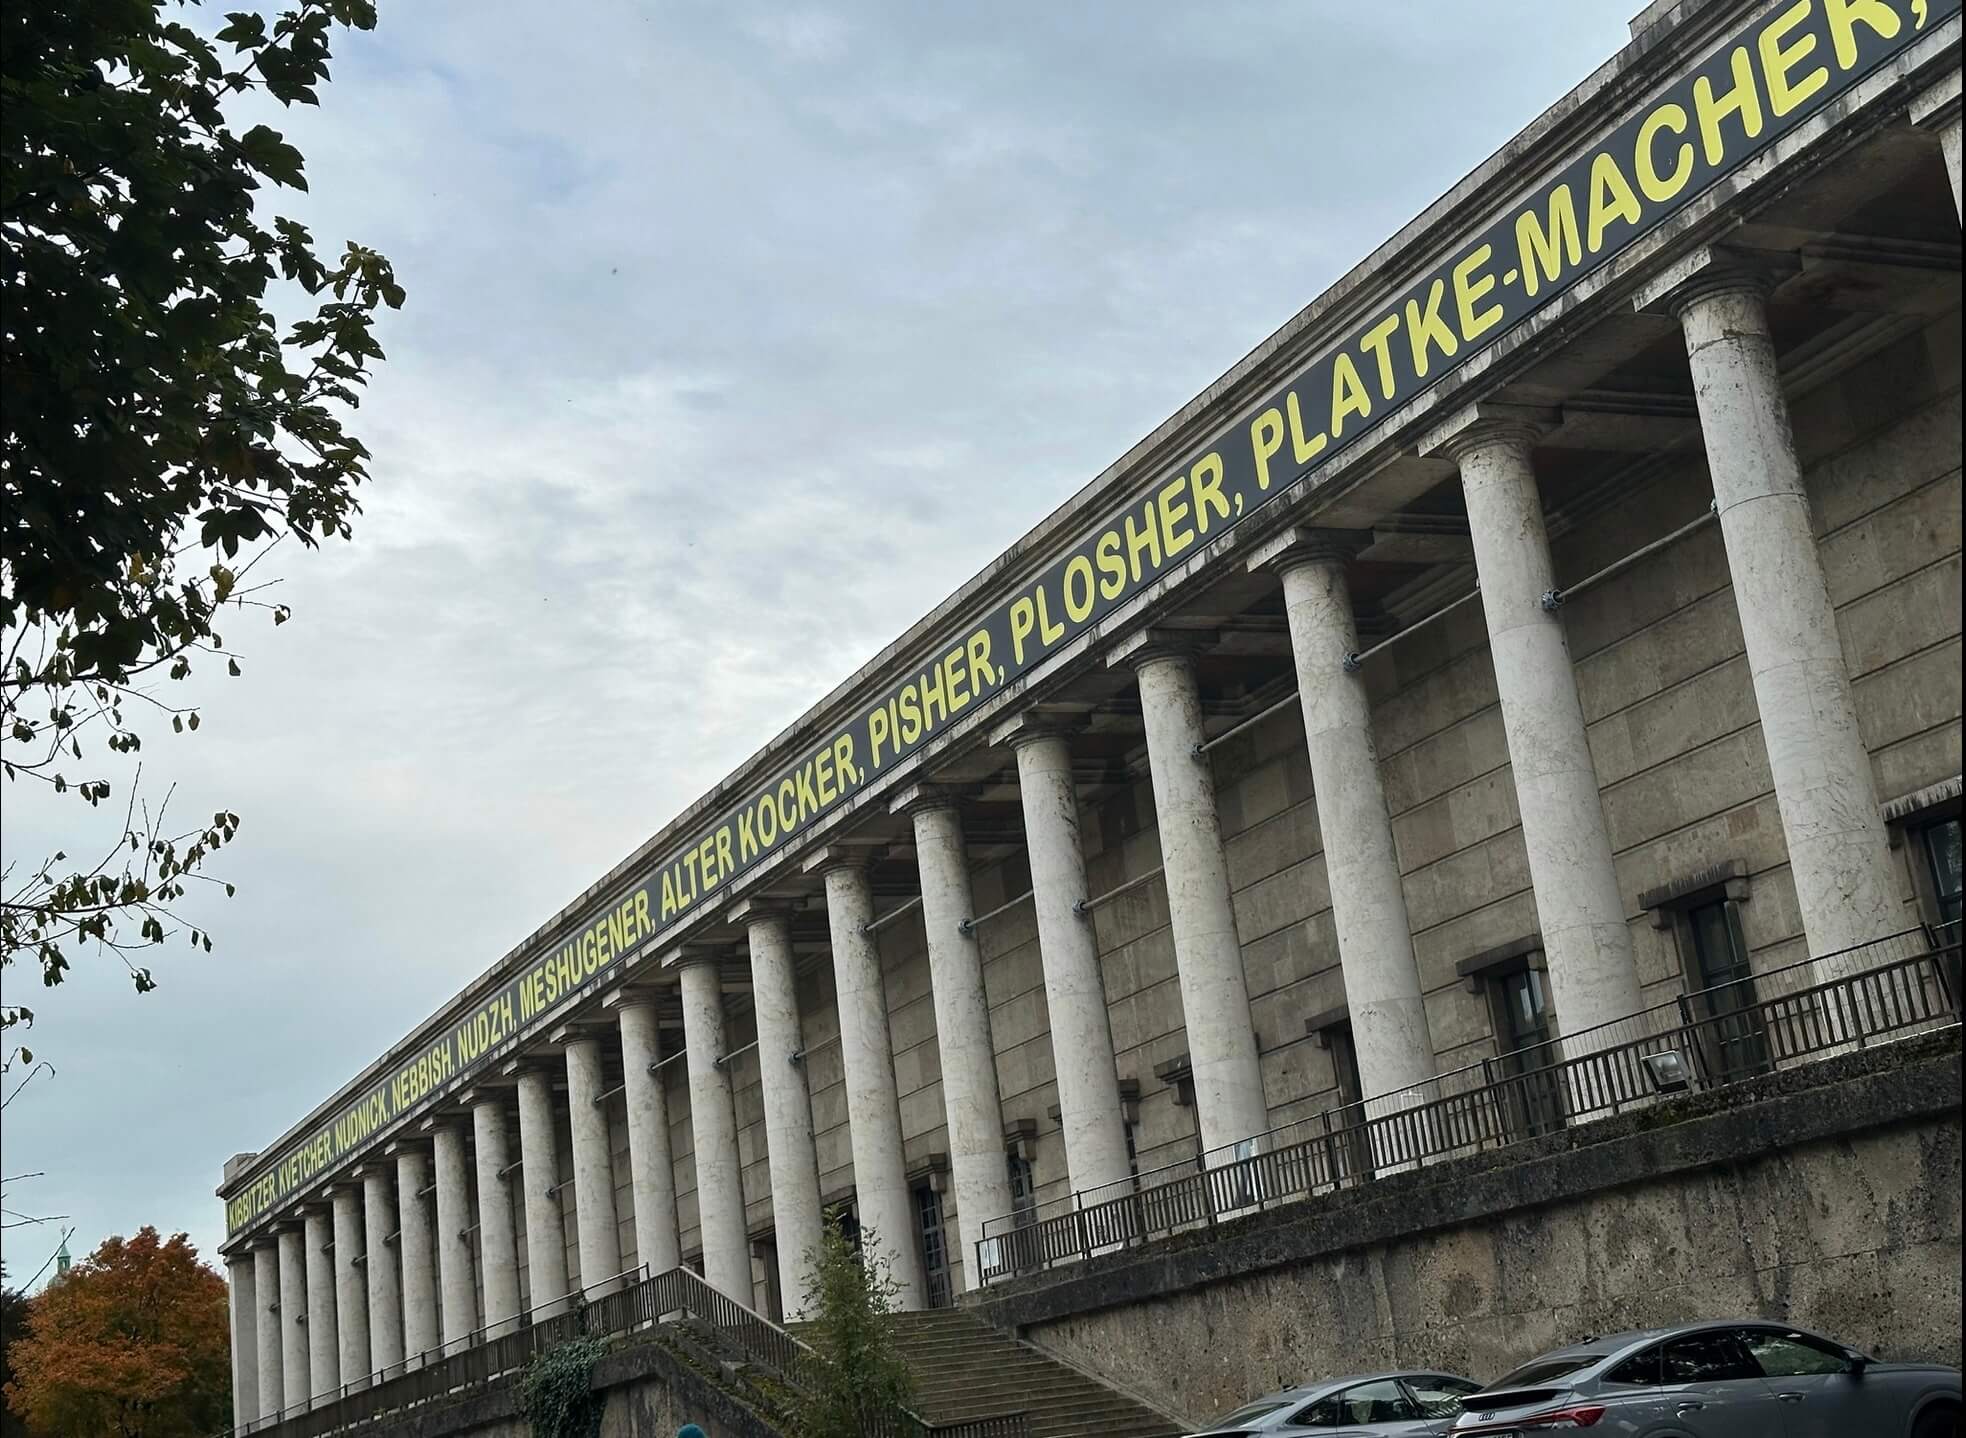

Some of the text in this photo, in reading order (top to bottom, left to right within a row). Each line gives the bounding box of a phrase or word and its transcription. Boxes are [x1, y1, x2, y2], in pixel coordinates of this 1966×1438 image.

[335, 1087, 390, 1156] NUDNICK,
[391, 1038, 455, 1115] NEBBISH,
[457, 991, 517, 1069] NUDZH,
[519, 888, 656, 1023] MESHUGENER,
[660, 825, 735, 922] ALTER
[738, 732, 864, 864] KOCKER,
[867, 628, 1005, 769] PISHER,
[1009, 450, 1244, 666] PLOSHER,
[1250, 0, 1928, 491] PLATKE-MACHER,
